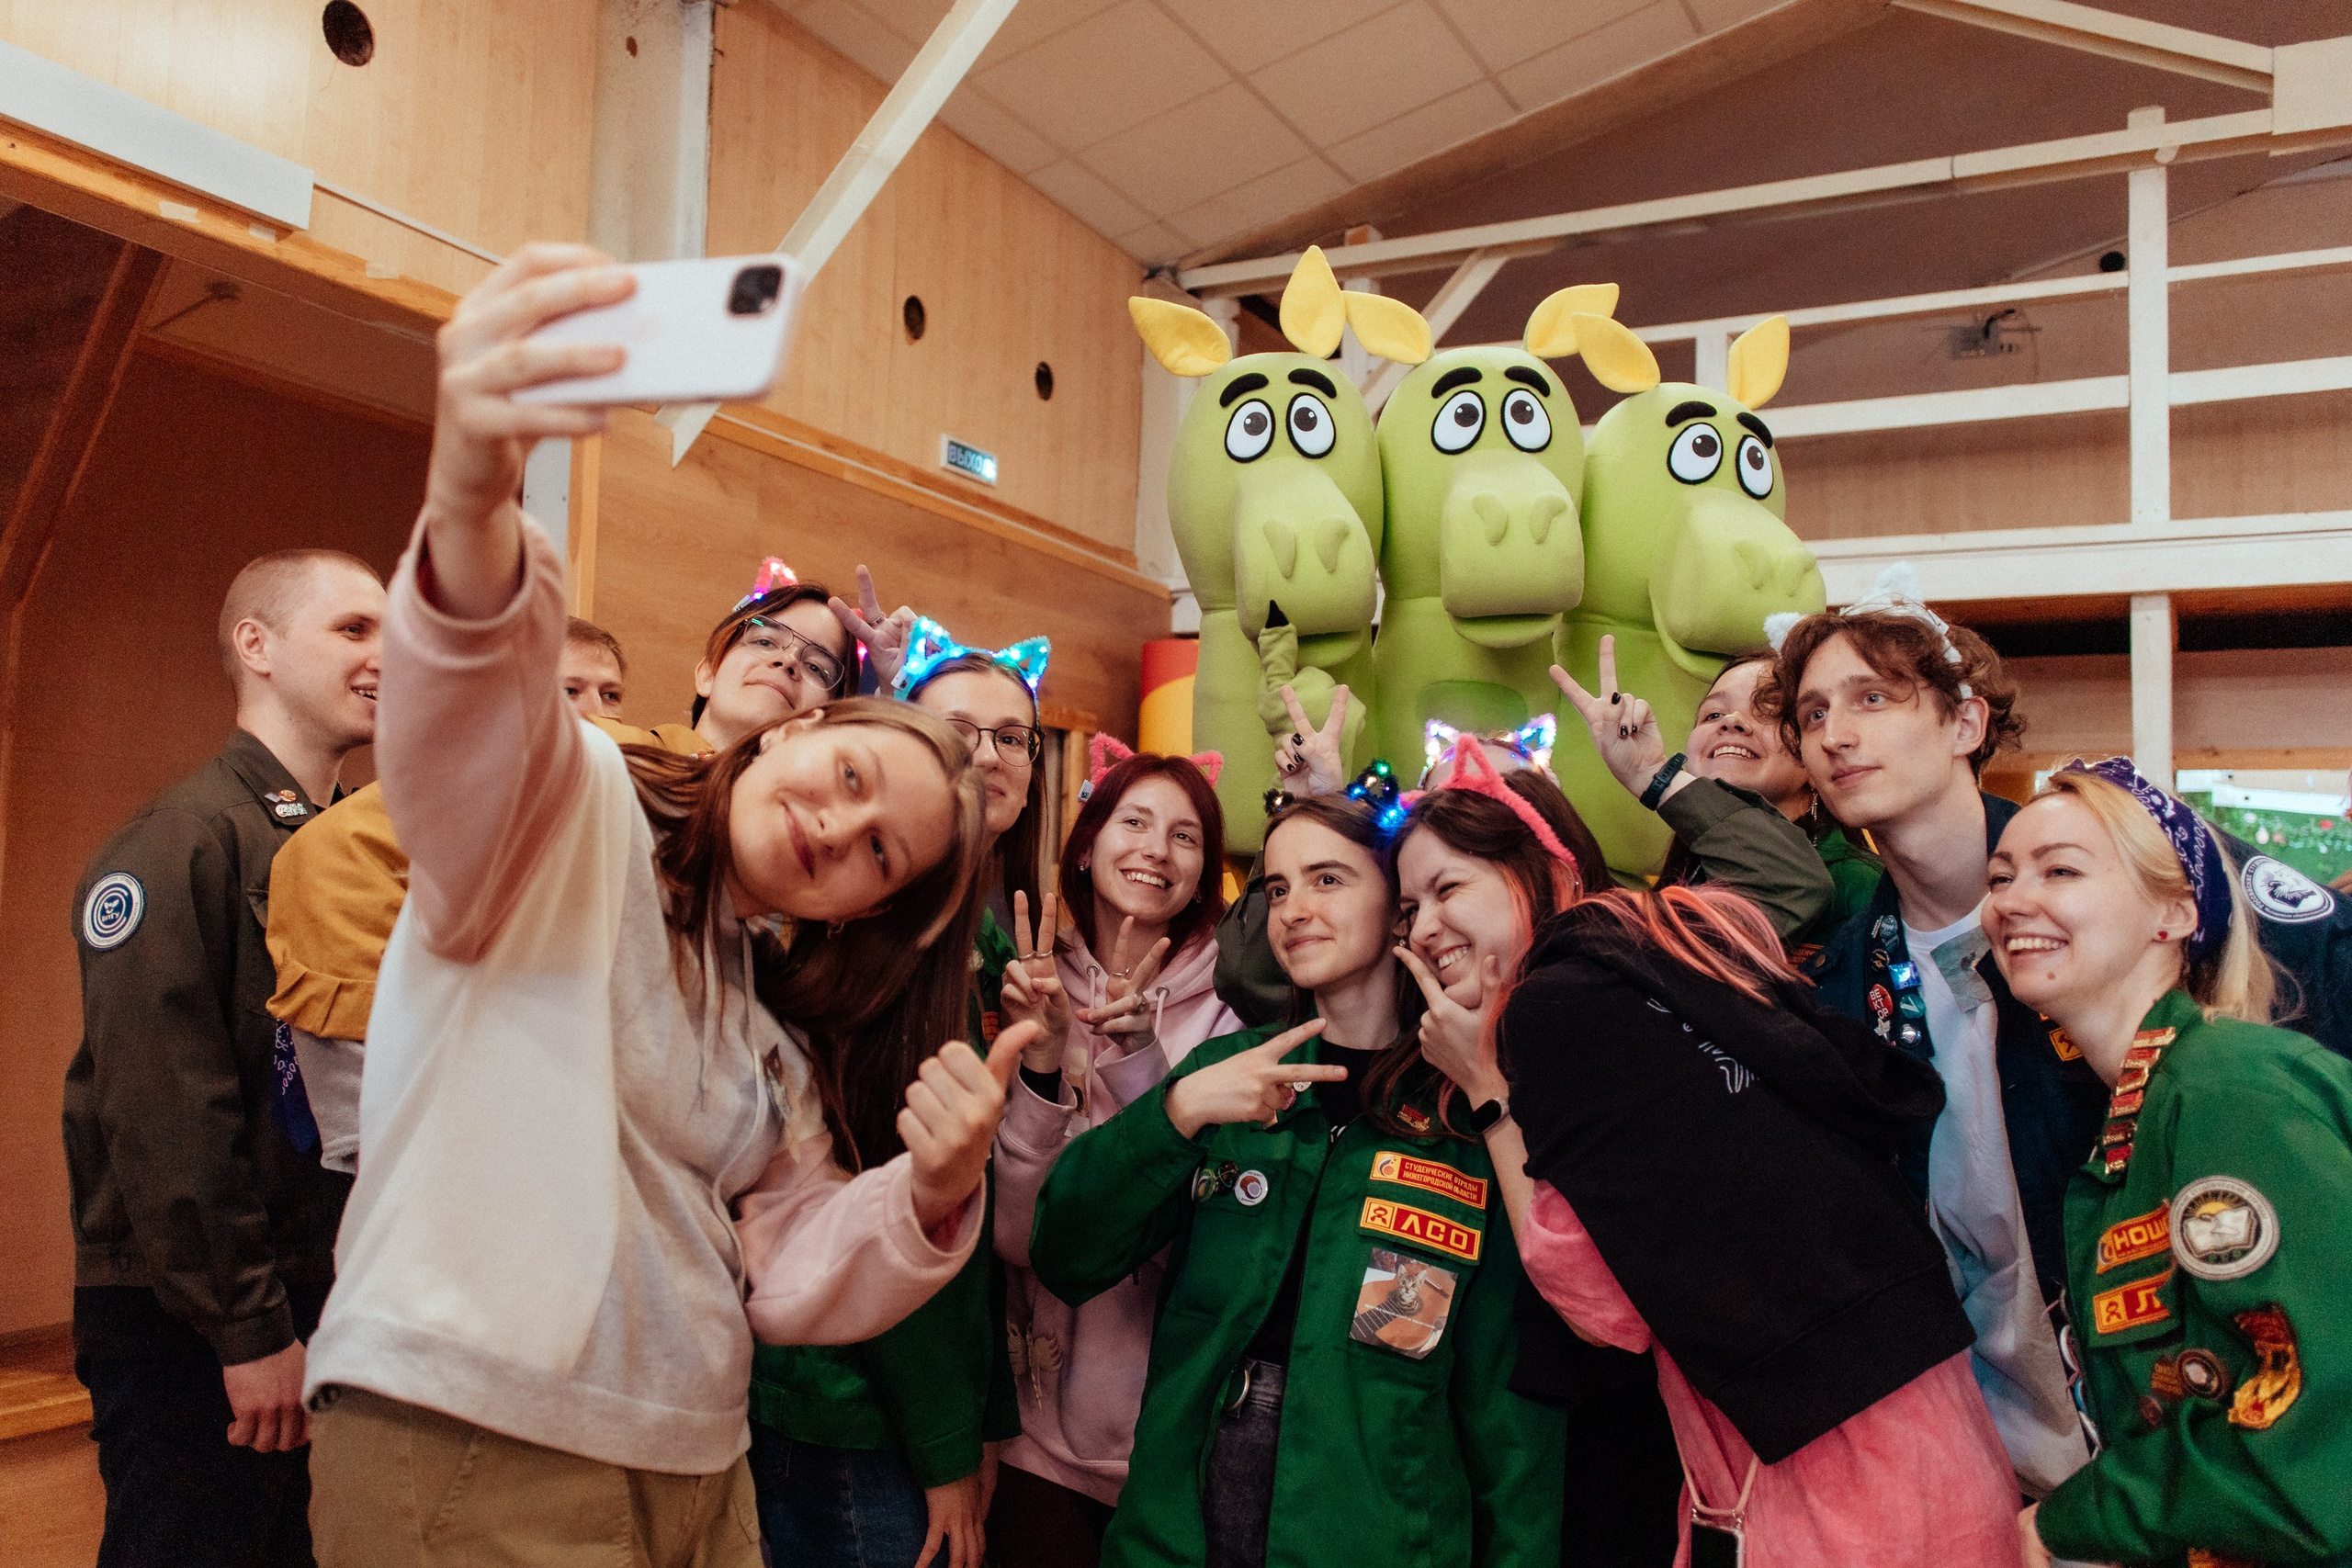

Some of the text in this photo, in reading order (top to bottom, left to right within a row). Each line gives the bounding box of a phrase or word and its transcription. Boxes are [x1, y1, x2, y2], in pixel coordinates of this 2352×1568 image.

[1403, 1170, 1477, 1201] НИЖЕГОРОДСКОЙ ОБЛАСТИ
[1405, 1162, 1478, 1192] СТУДЕНЧЕСКИЕ ОТРЯДЫ
